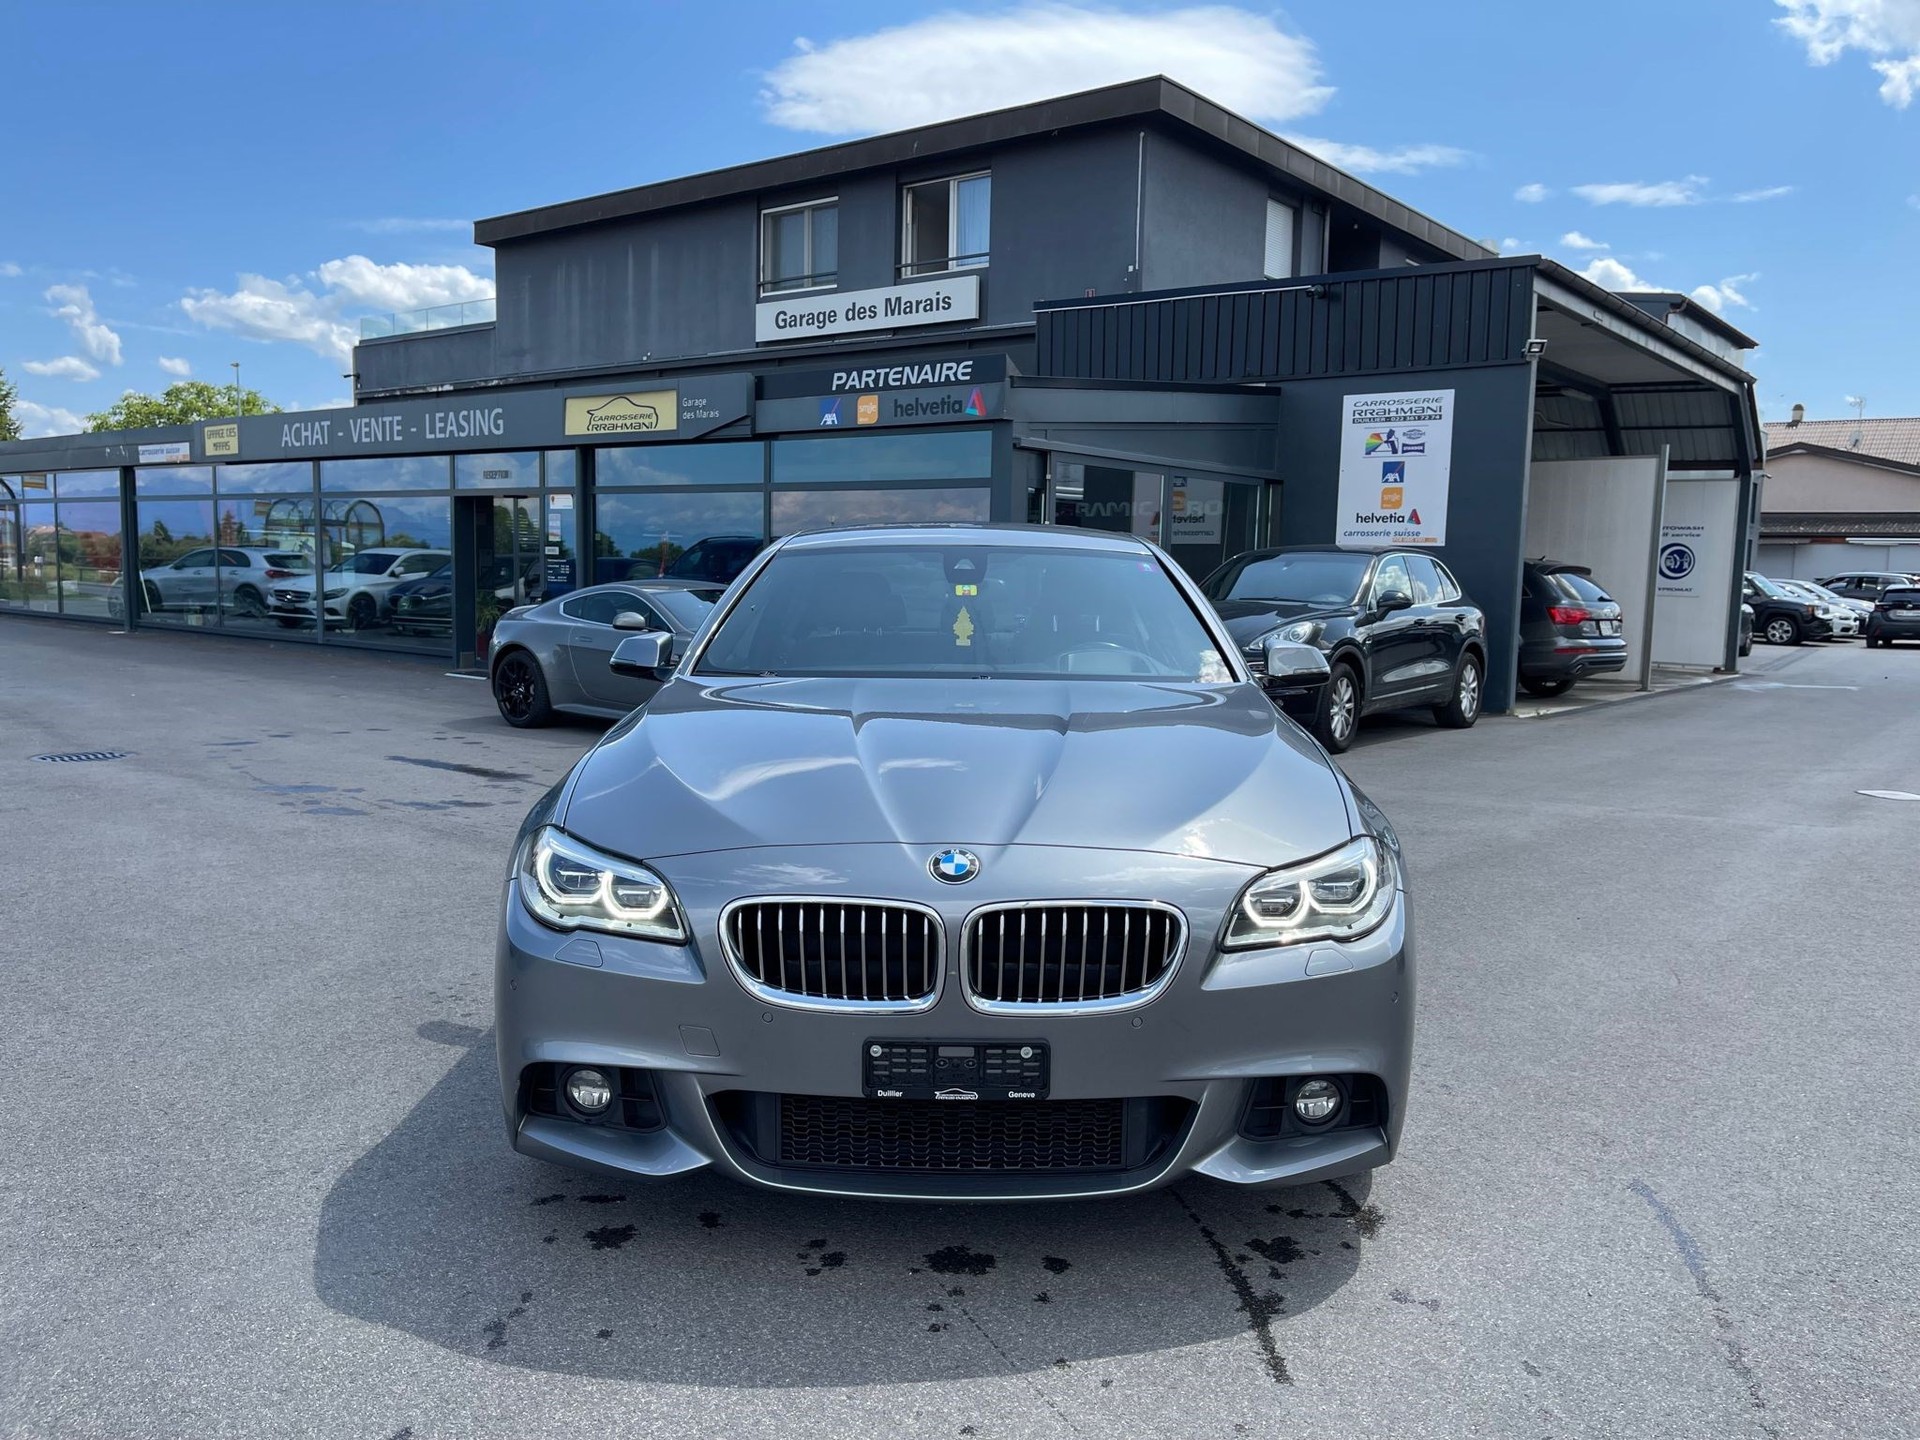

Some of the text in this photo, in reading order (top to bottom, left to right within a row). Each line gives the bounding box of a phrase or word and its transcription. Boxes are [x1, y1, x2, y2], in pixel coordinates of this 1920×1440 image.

[775, 291, 952, 330] Garage des Marais
[831, 360, 973, 391] PARTENAIRE
[682, 397, 707, 407] Garage
[893, 395, 963, 418] helvetia
[1353, 396, 1444, 408] CARROSSERIE
[592, 412, 653, 422] CARROSSERIE
[682, 409, 720, 420] des Marais
[820, 413, 838, 425] AXA
[281, 420, 331, 448] ACHAT
[350, 416, 403, 443] VENTE
[425, 407, 504, 439] LEASING
[1382, 472, 1400, 482] AXA
[1355, 512, 1405, 523] helvetia
[1343, 528, 1421, 537] carrosserie suisse
[877, 1089, 903, 1098] Duillier
